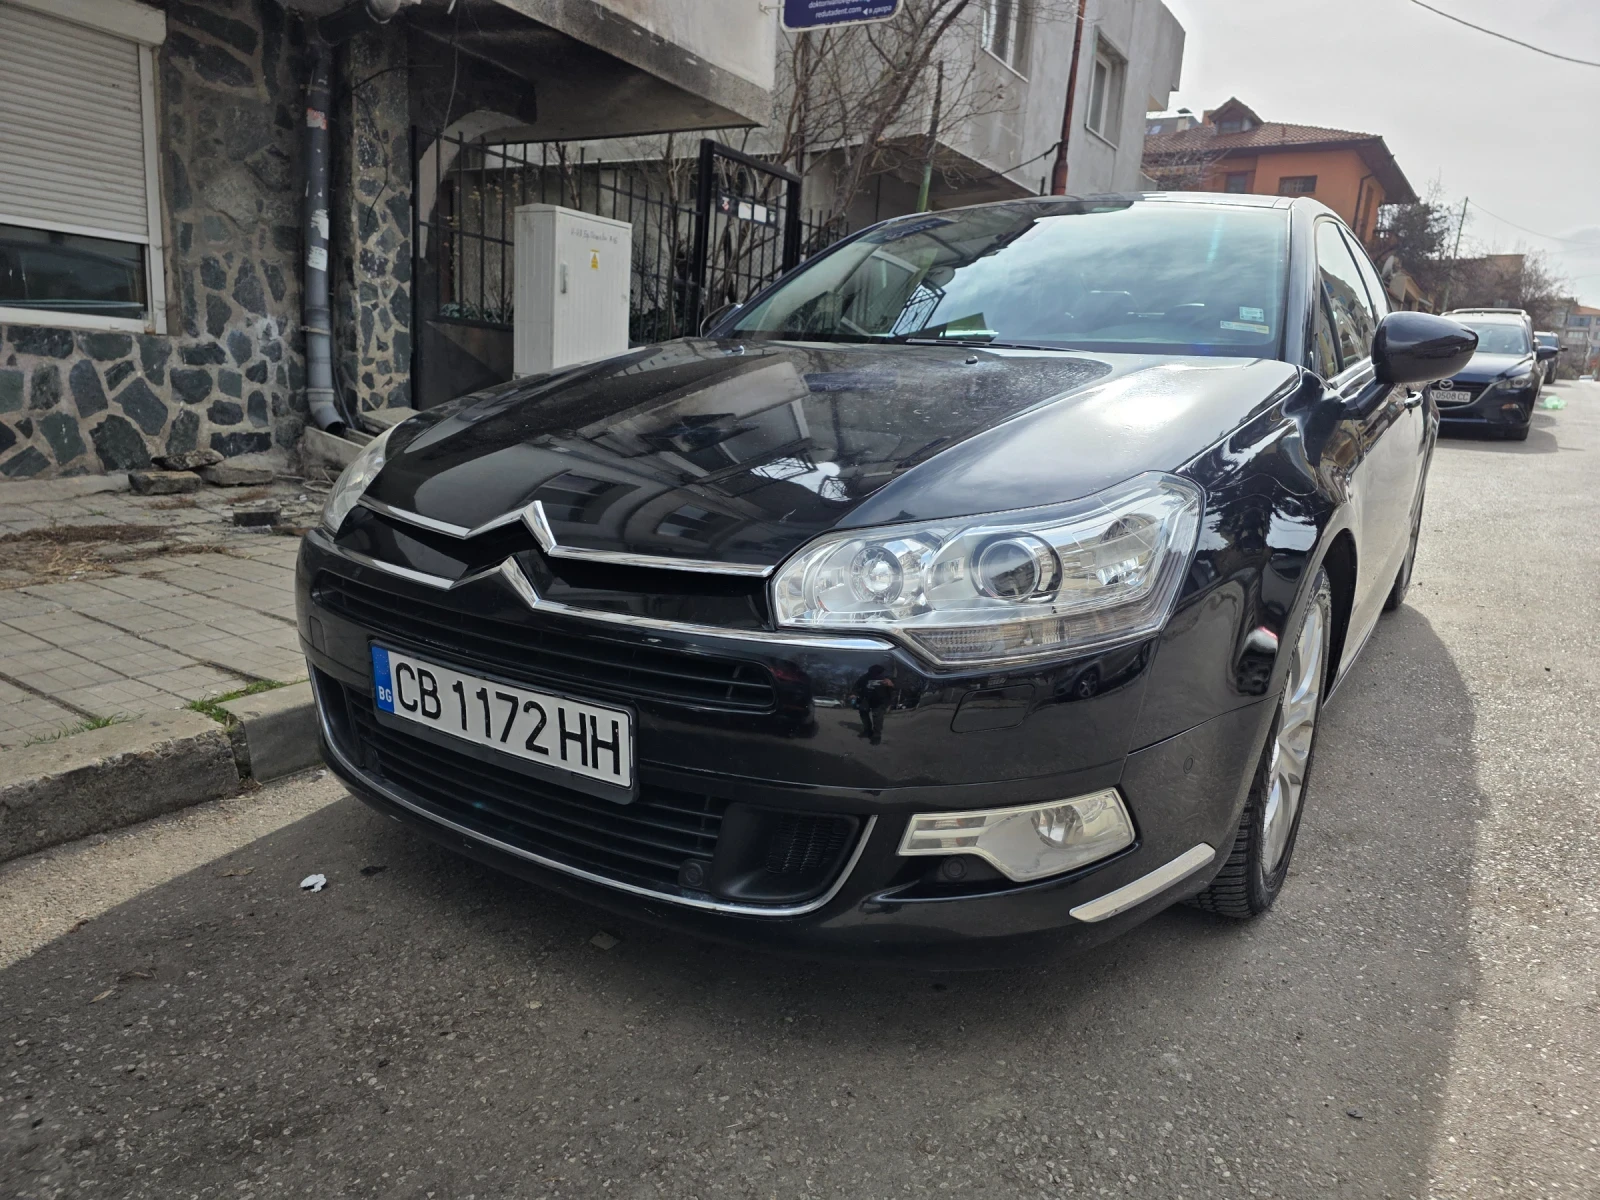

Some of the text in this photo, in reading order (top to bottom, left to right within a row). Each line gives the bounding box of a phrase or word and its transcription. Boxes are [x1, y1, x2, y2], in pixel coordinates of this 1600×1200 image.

[1435, 391, 1469, 401] 0508 CC
[378, 685, 392, 703] BG
[395, 662, 621, 776] CB 1172 HH
